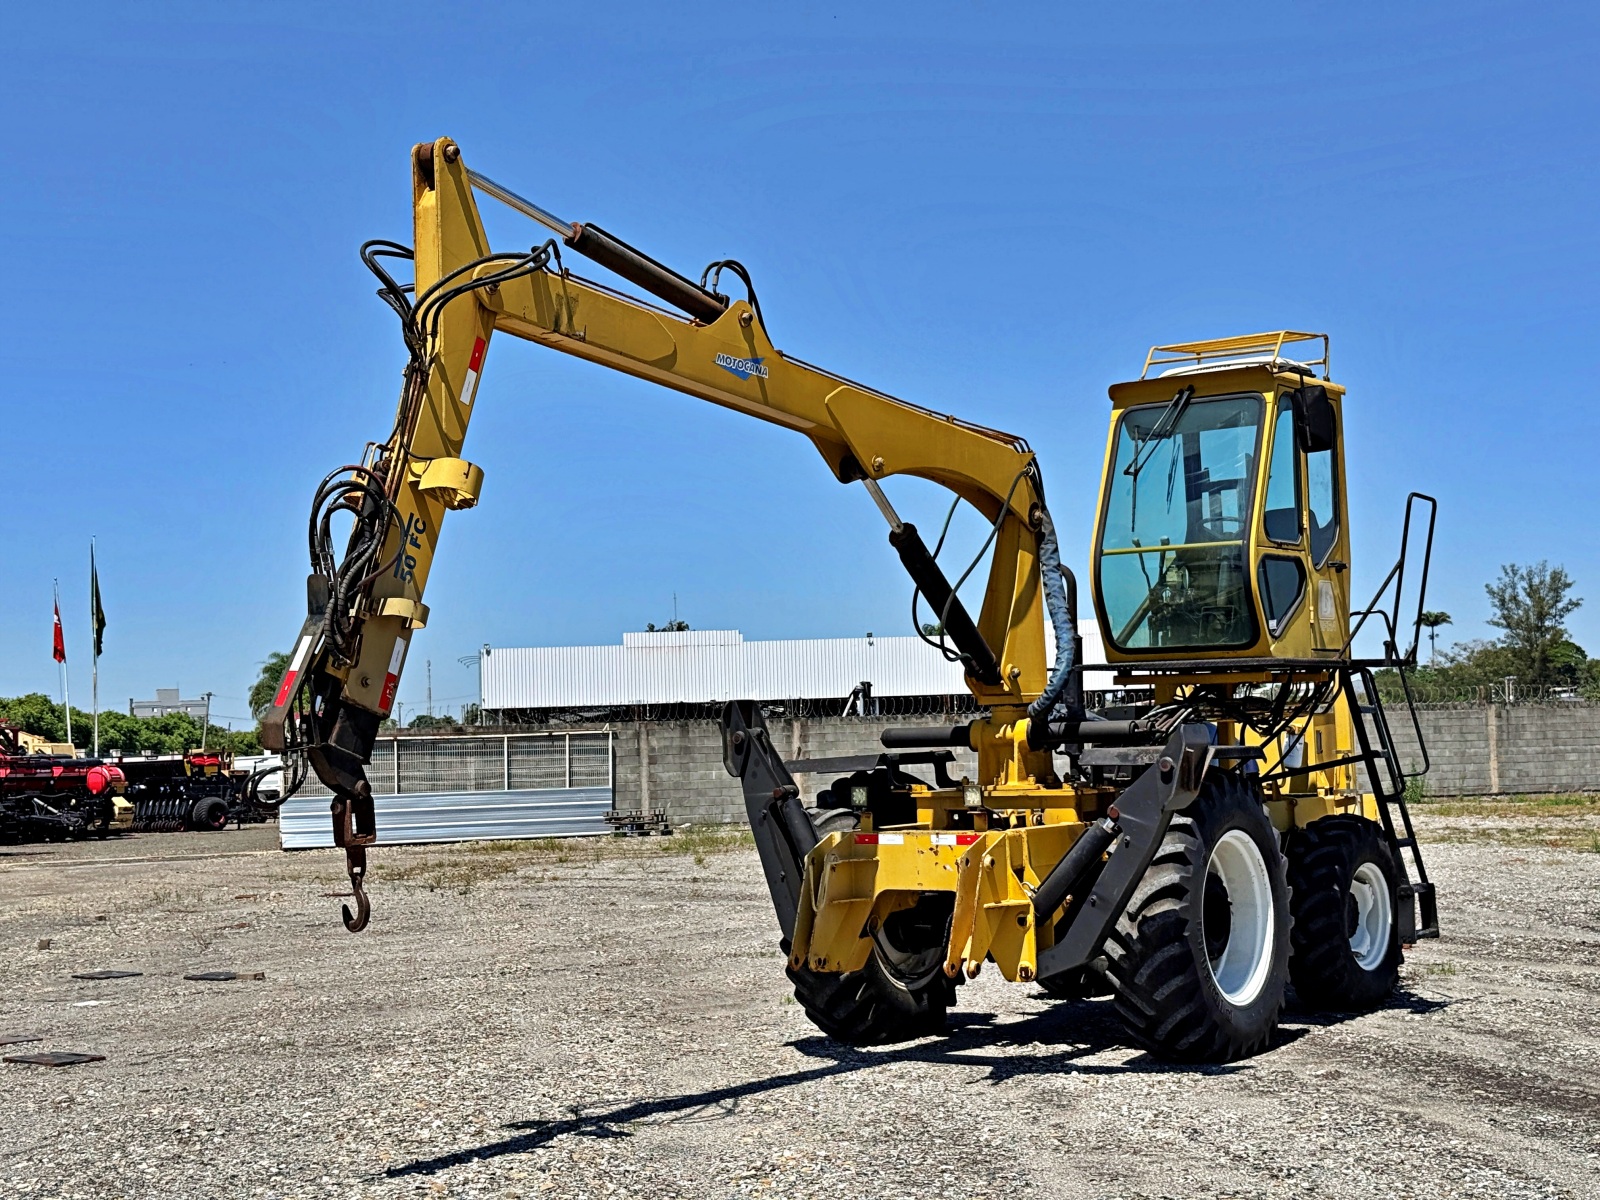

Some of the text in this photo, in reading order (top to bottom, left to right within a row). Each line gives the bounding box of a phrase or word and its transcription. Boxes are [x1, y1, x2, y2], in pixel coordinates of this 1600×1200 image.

[716, 353, 768, 378] MOTOCANA
[400, 517, 427, 585] 50 FC
